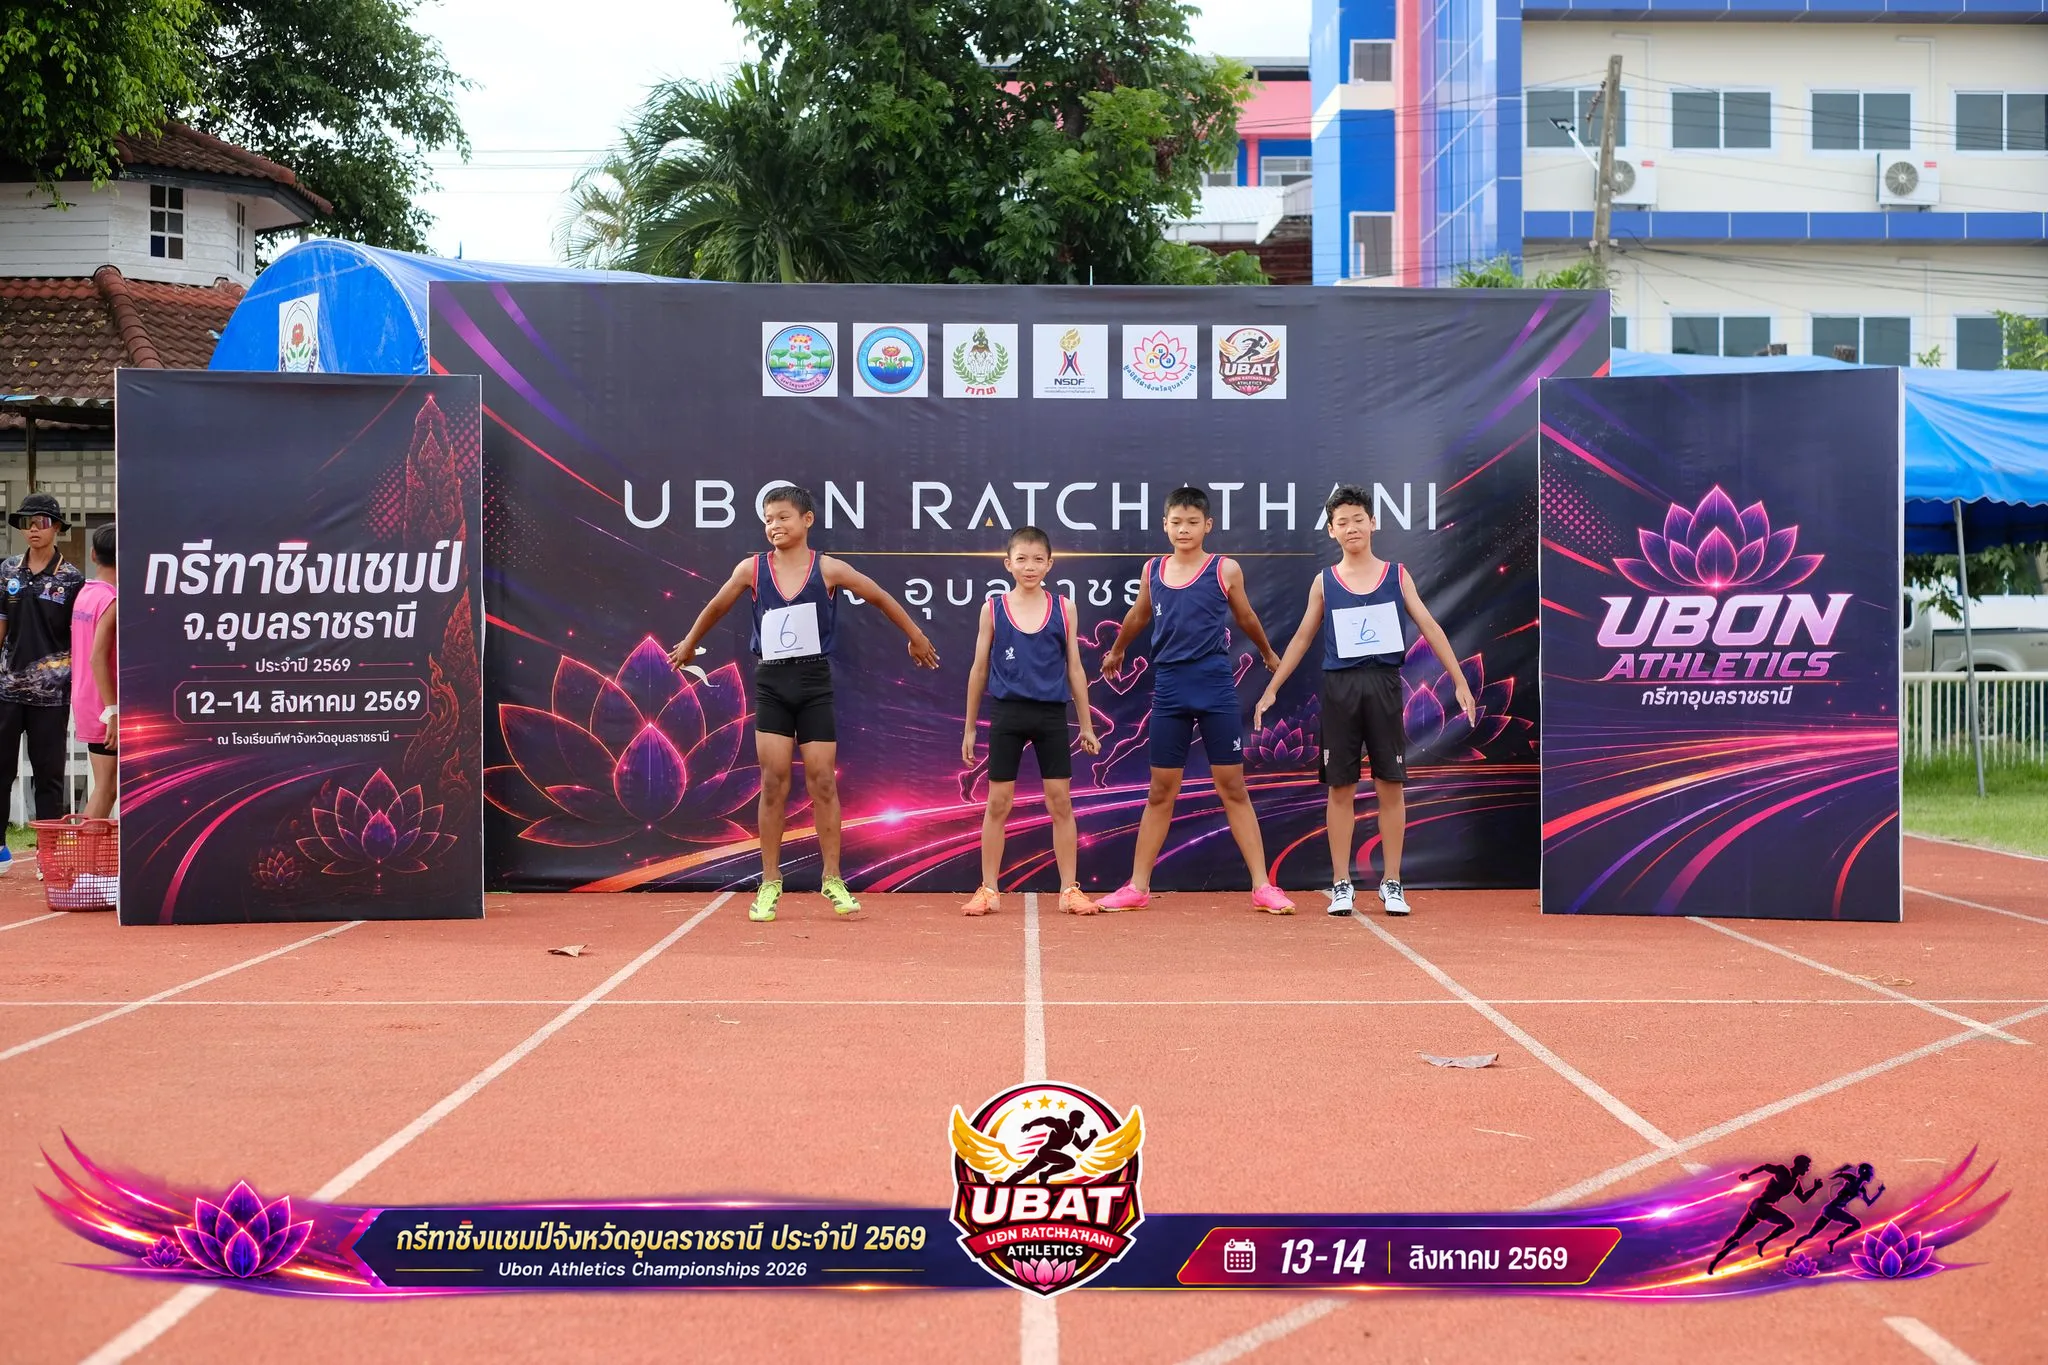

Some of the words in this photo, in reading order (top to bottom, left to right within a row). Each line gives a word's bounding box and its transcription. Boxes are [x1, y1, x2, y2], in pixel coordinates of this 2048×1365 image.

[1054, 378, 1085, 386] NSDF
[1224, 363, 1275, 376] UBAT
[912, 481, 1437, 531] RATCHTHNI
[184, 601, 417, 651] จ.อุบลราชธานี
[780, 613, 798, 649] 6
[1597, 593, 1853, 647] UBON
[255, 657, 308, 673] ประจำปี
[313, 658, 351, 672] 2569
[1603, 652, 1841, 680] ATHLETICS
[270, 690, 356, 713] สิงหาคม
[364, 690, 421, 712] 2569
[1641, 685, 1794, 710] กรีฑาอุบลราชธานี
[217, 735, 229, 745] ณ
[232, 730, 390, 747] โรงเรียนกีฬาจังหวัดอุบลราชธานี
